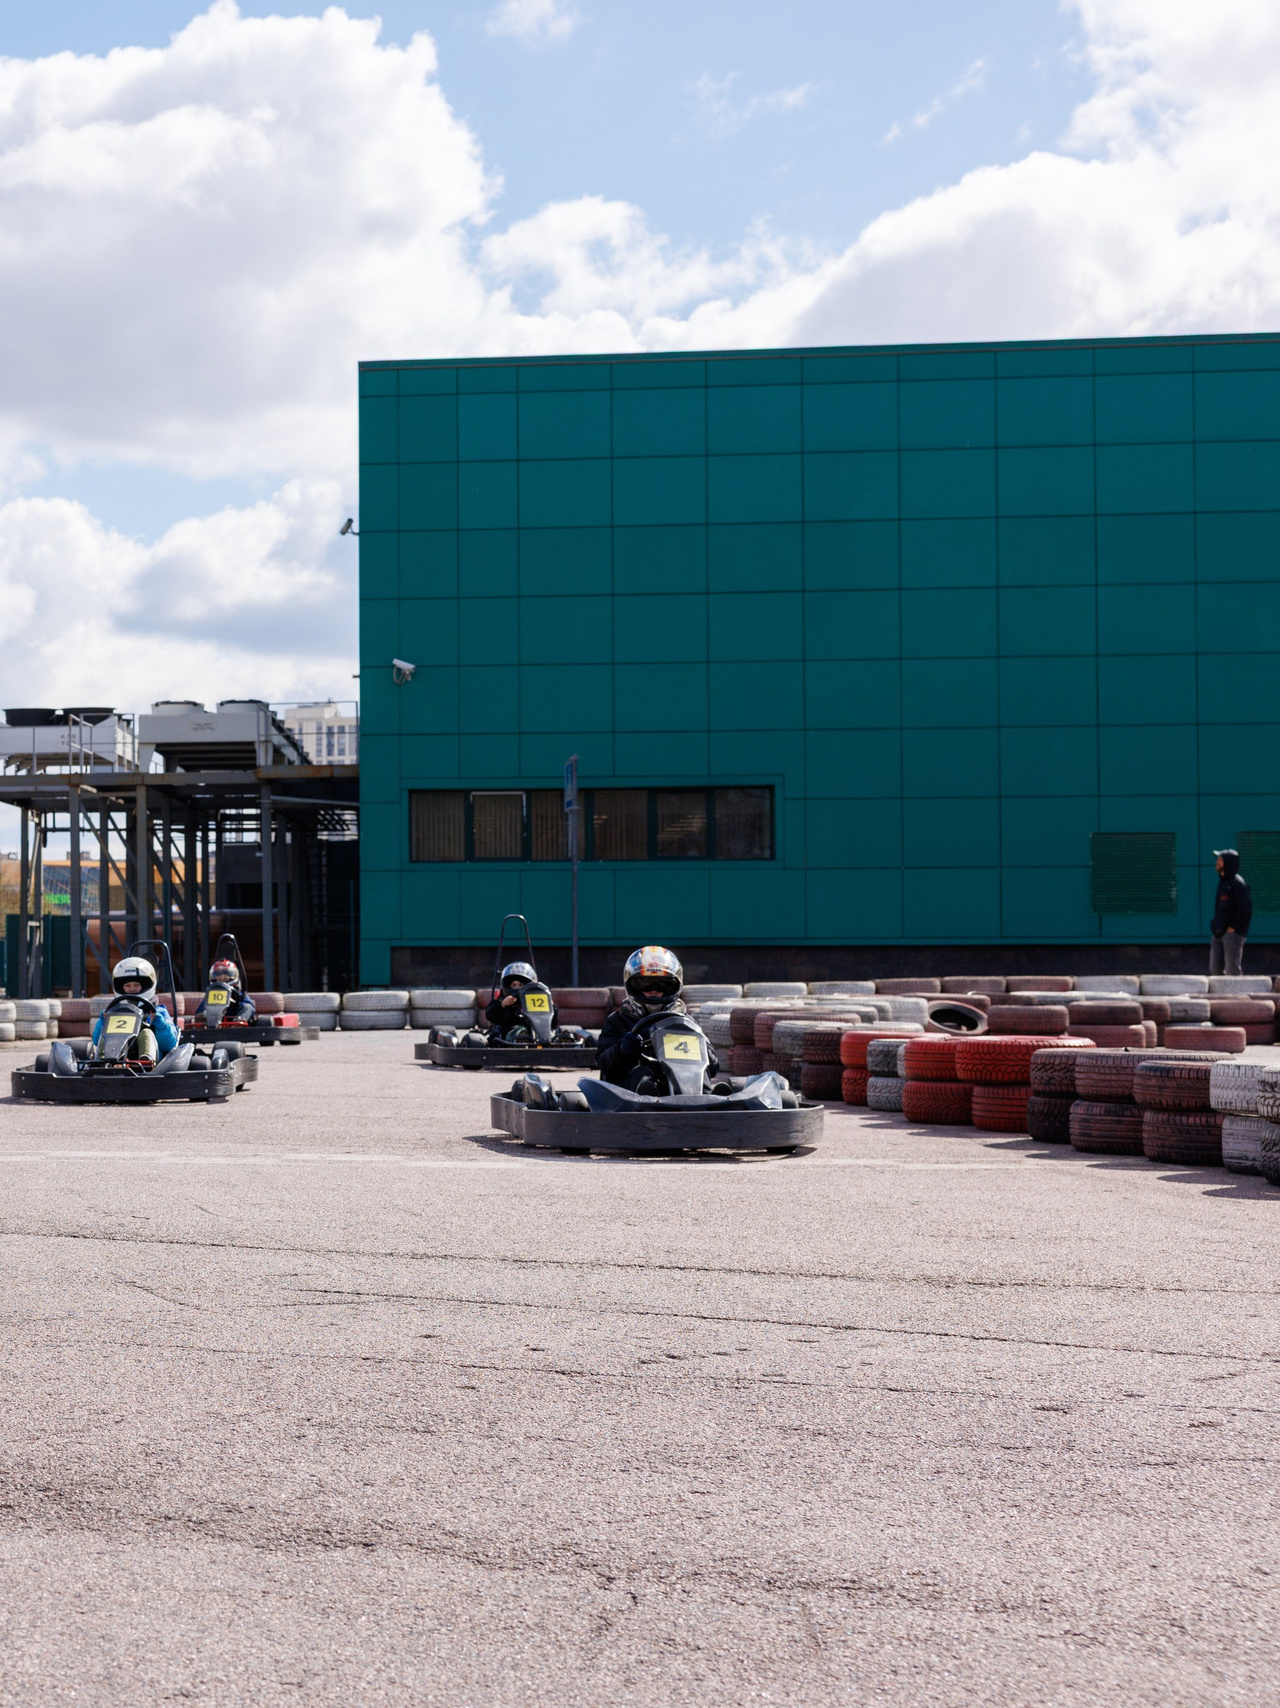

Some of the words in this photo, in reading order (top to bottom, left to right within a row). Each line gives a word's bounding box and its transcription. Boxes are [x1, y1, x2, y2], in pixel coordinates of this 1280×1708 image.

[531, 998, 544, 1007] 12
[115, 1020, 127, 1028] 2
[674, 1041, 690, 1053] 4
